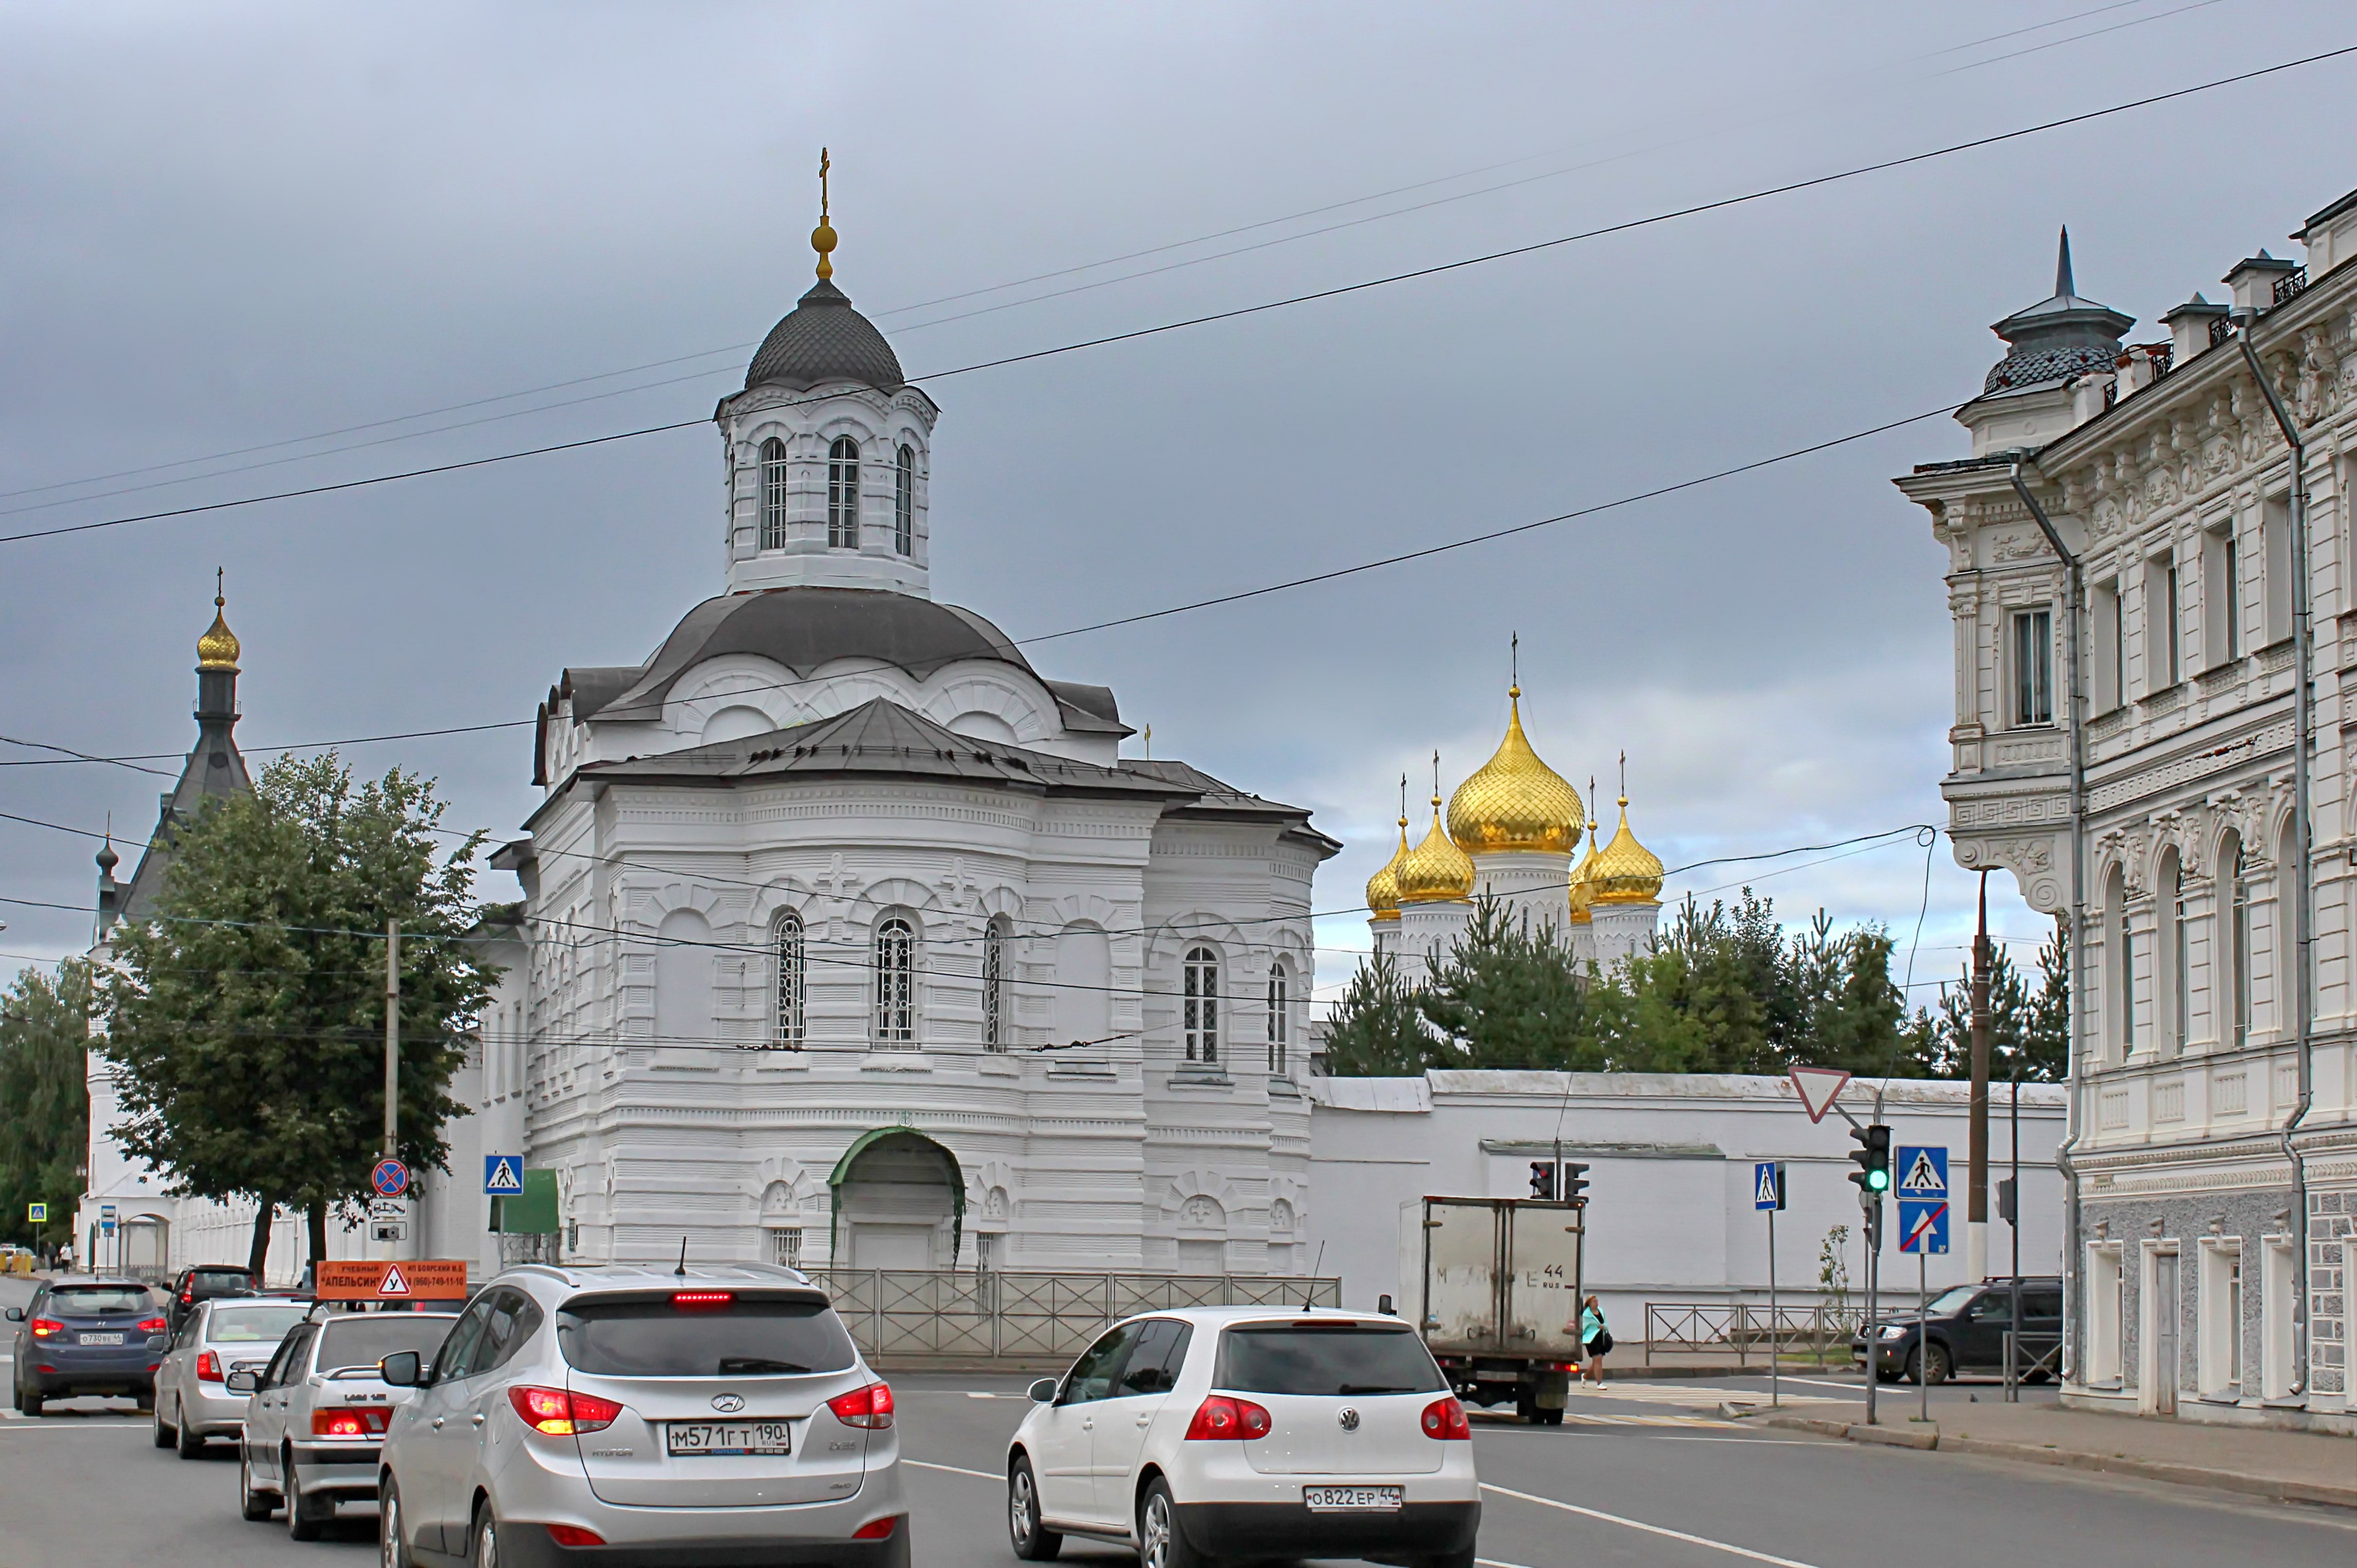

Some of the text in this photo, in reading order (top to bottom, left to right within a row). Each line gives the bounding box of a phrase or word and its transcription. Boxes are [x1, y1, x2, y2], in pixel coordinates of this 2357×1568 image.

[418, 1264, 450, 1272] БОЯРСКИЙ
[1544, 1264, 1563, 1278] 44
[755, 1424, 783, 1440] 190
[1380, 1488, 1395, 1500] 44
